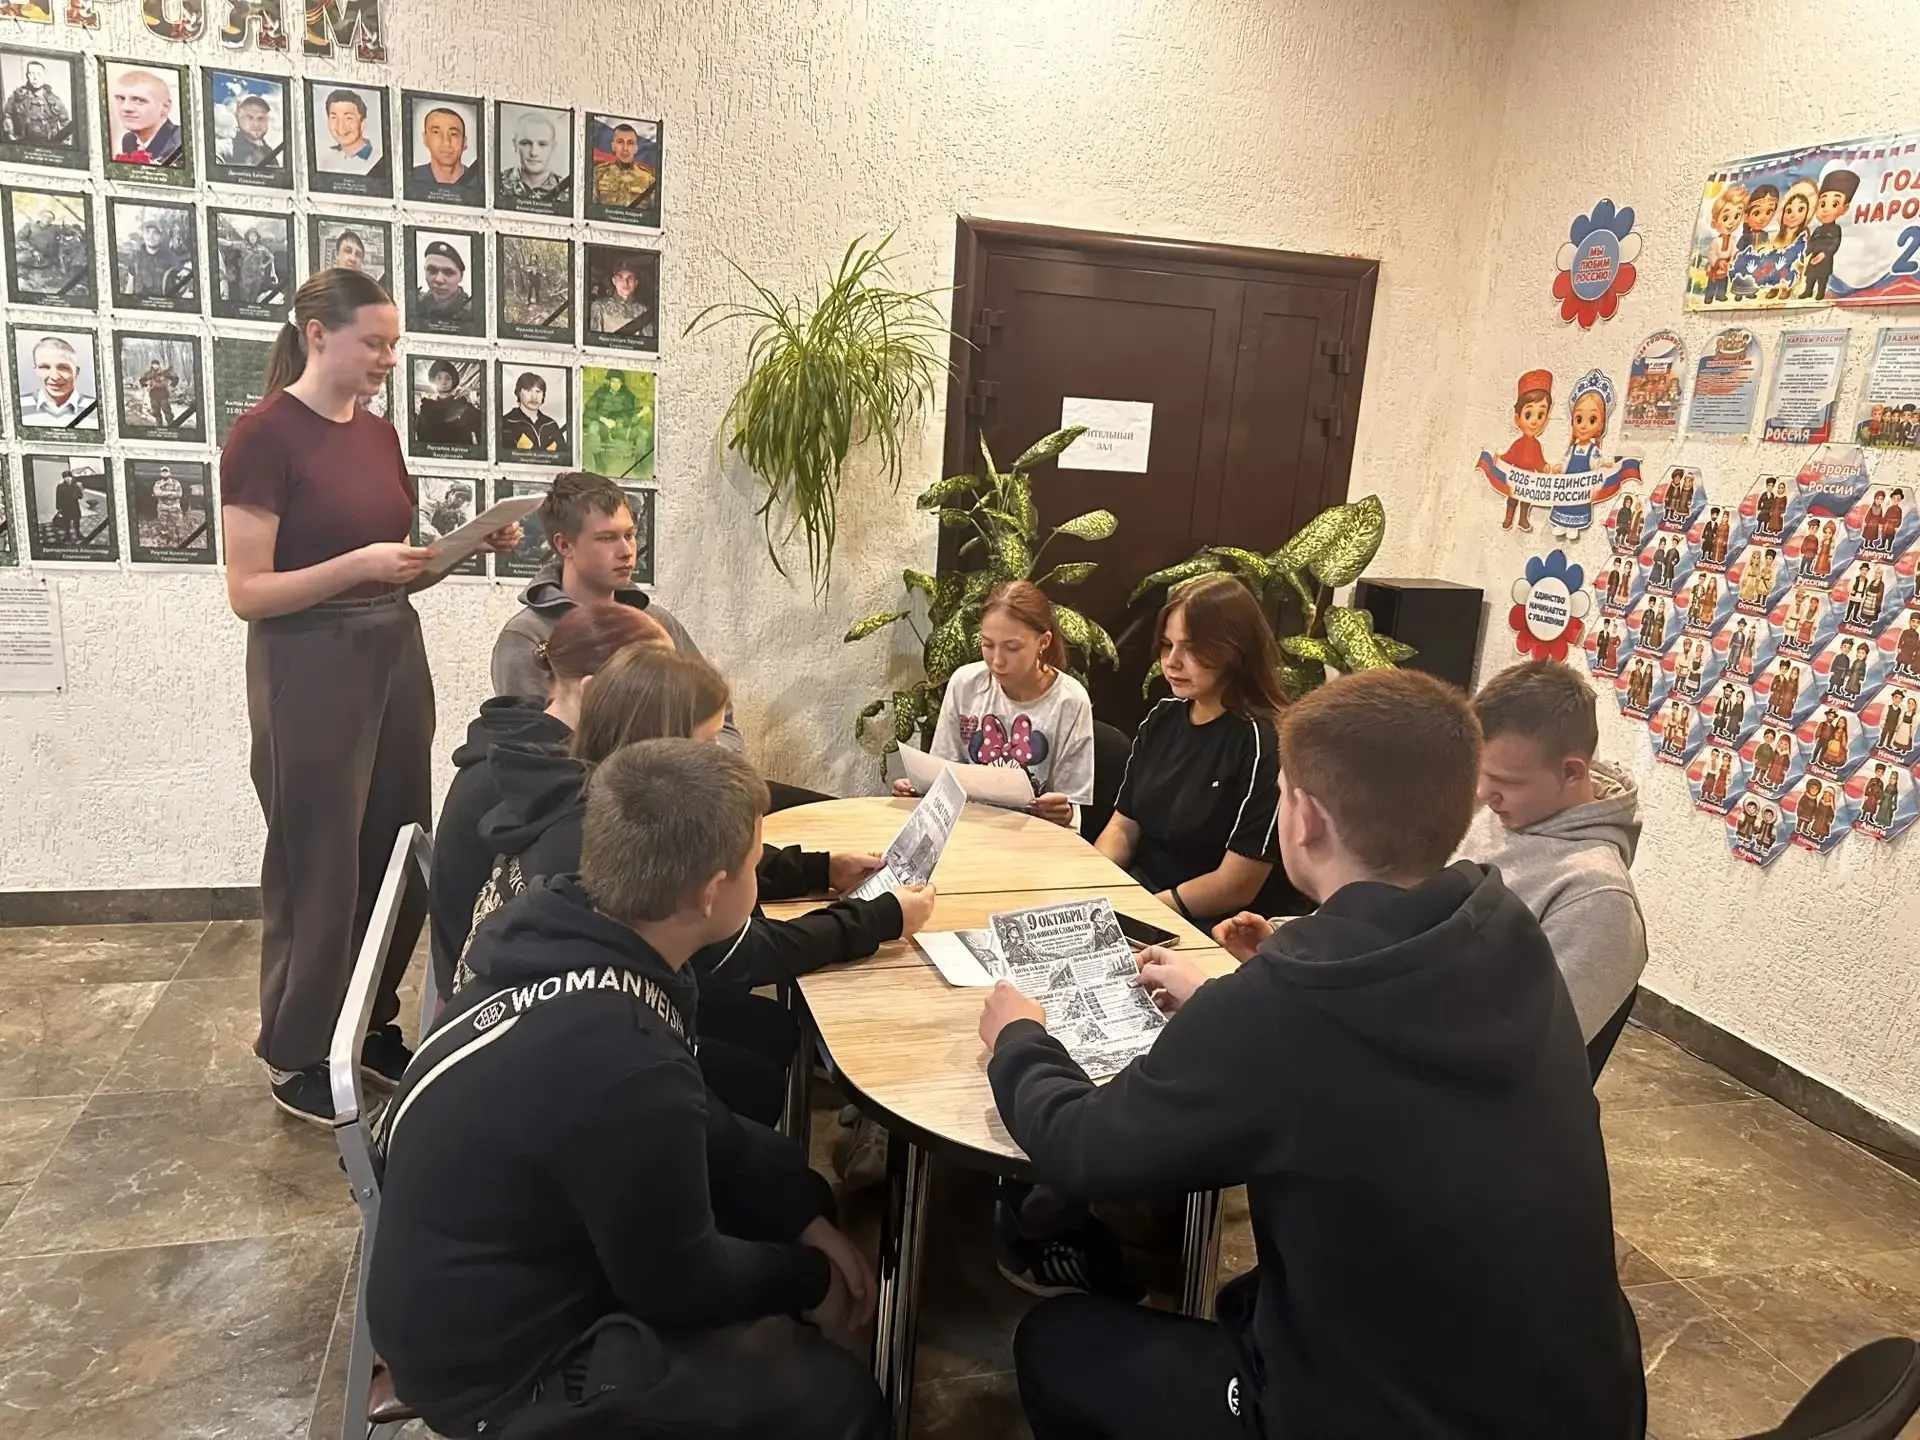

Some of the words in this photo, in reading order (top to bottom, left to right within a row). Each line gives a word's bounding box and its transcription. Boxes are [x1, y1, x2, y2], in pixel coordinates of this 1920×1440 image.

[1854, 197, 1920, 225] НАРО
[1590, 247, 1604, 257] МЫ
[1580, 258, 1610, 270] ЛЮБИМ
[1575, 271, 1610, 283] РОССИЮ!
[1787, 335, 1813, 344] НАРОДЫ
[1815, 335, 1844, 343] РОССИИ
[1765, 428, 1810, 441] РОССИЯ
[1096, 443, 1113, 451] ЗАЛ
[1810, 462, 1860, 477] Народы
[1508, 470, 1530, 486] 2026
[1535, 477, 1552, 488] ГОД
[1554, 474, 1604, 490] ЕДИНСТВА
[1514, 485, 1550, 501] НАРОДОВ
[1553, 489, 1591, 502] РОССИИ
[1808, 481, 1854, 496] России
[1859, 548, 1894, 560] Удмурты
[1796, 576, 1829, 588] Русские
[1534, 591, 1565, 604] ЕДИНСТВО
[1529, 602, 1568, 617] НАЧИНАЕТСЯ
[1738, 603, 1766, 613] Осетины
[1533, 613, 1565, 627] УВАЖЕНИЯ
[1845, 624, 1873, 635] Карелы
[1778, 645, 1812, 659] Марийцы
[1828, 695, 1855, 708] Буряты
[1763, 714, 1794, 730] Лезгины
[1877, 749, 1905, 764] Немцы
[1752, 783, 1774, 797] Ханты
[1861, 821, 1887, 836] Адыги
[1738, 846, 1762, 864] Чукчи
[1027, 913, 1037, 930] 9
[1038, 909, 1083, 927] ОКТЯБРЯ
